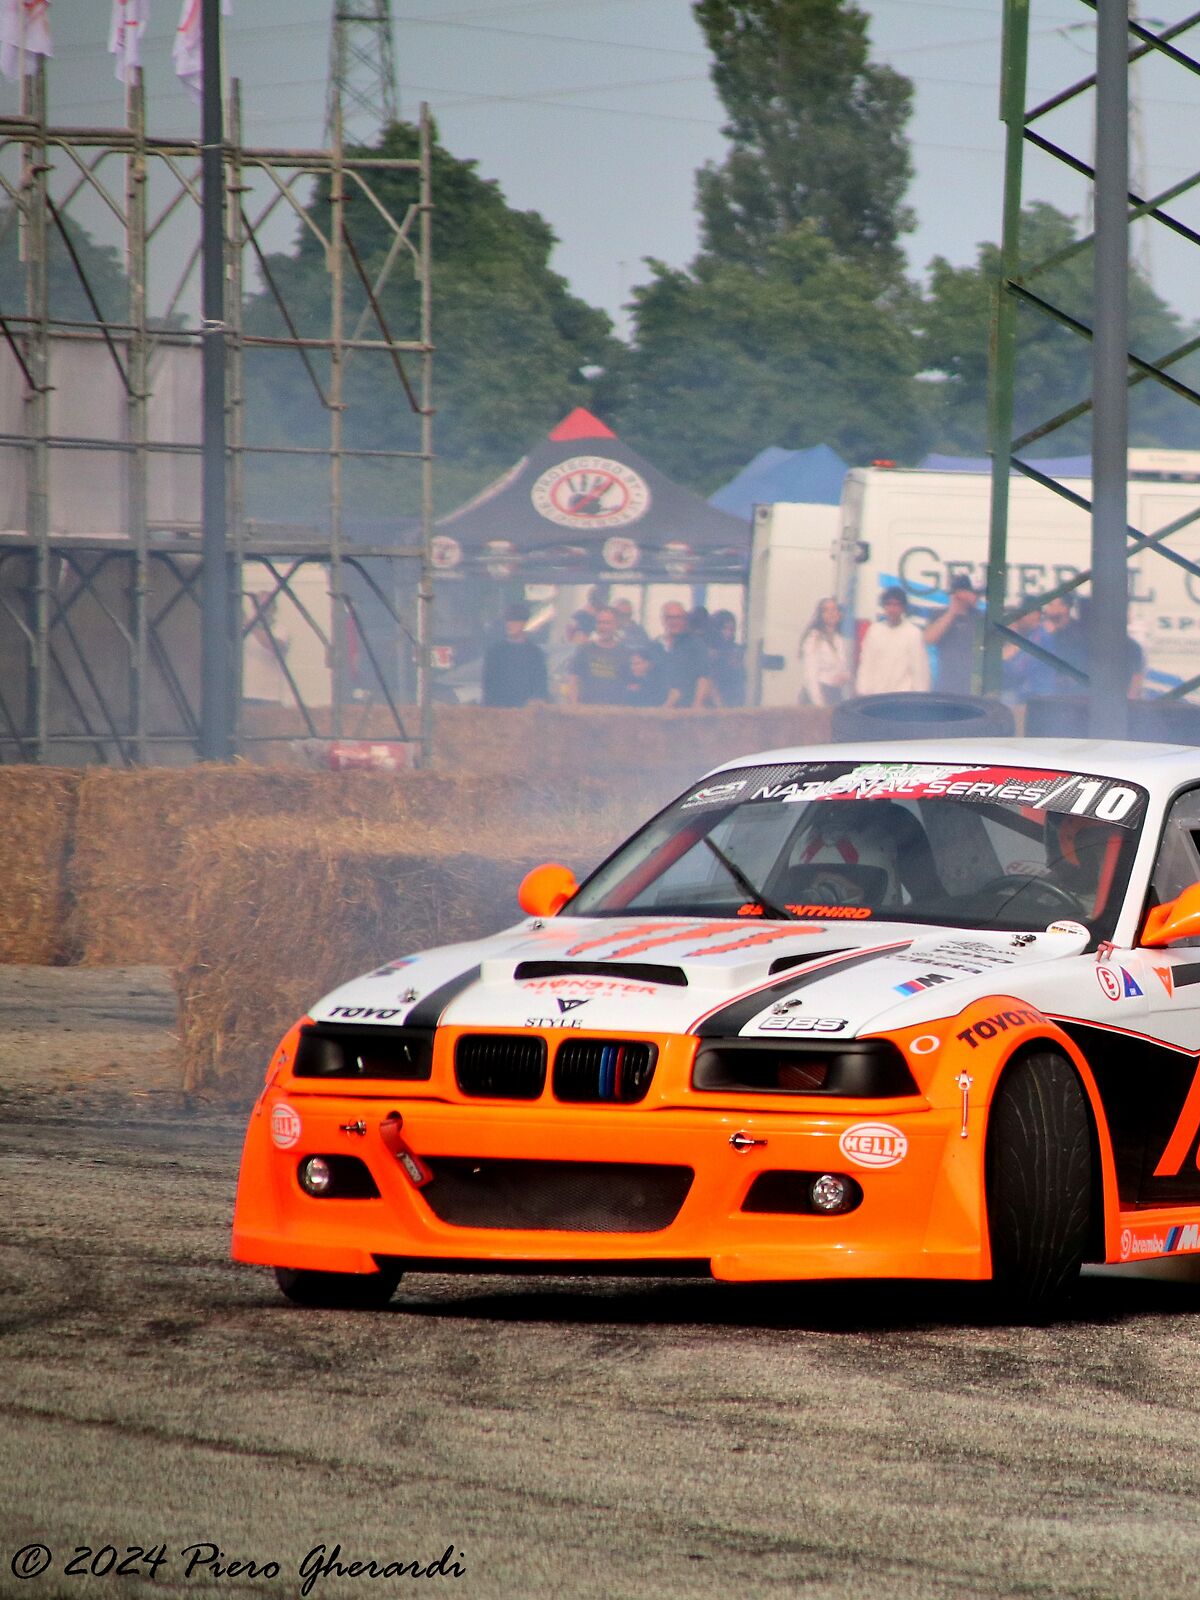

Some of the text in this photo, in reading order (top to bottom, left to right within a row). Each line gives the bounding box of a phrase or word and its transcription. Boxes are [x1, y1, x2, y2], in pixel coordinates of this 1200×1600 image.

[899, 546, 1155, 603] GEERL
[922, 780, 1047, 801] SERIES
[1069, 781, 1139, 821] 10
[736, 902, 872, 919] SENTHIRD
[523, 978, 658, 995] MONSTER
[328, 1005, 402, 1020] TOYO
[525, 1017, 583, 1029] STYLE
[758, 1015, 849, 1032] BBS
[844, 1135, 907, 1158] HELLA
[1131, 1233, 1165, 1253] brembo
